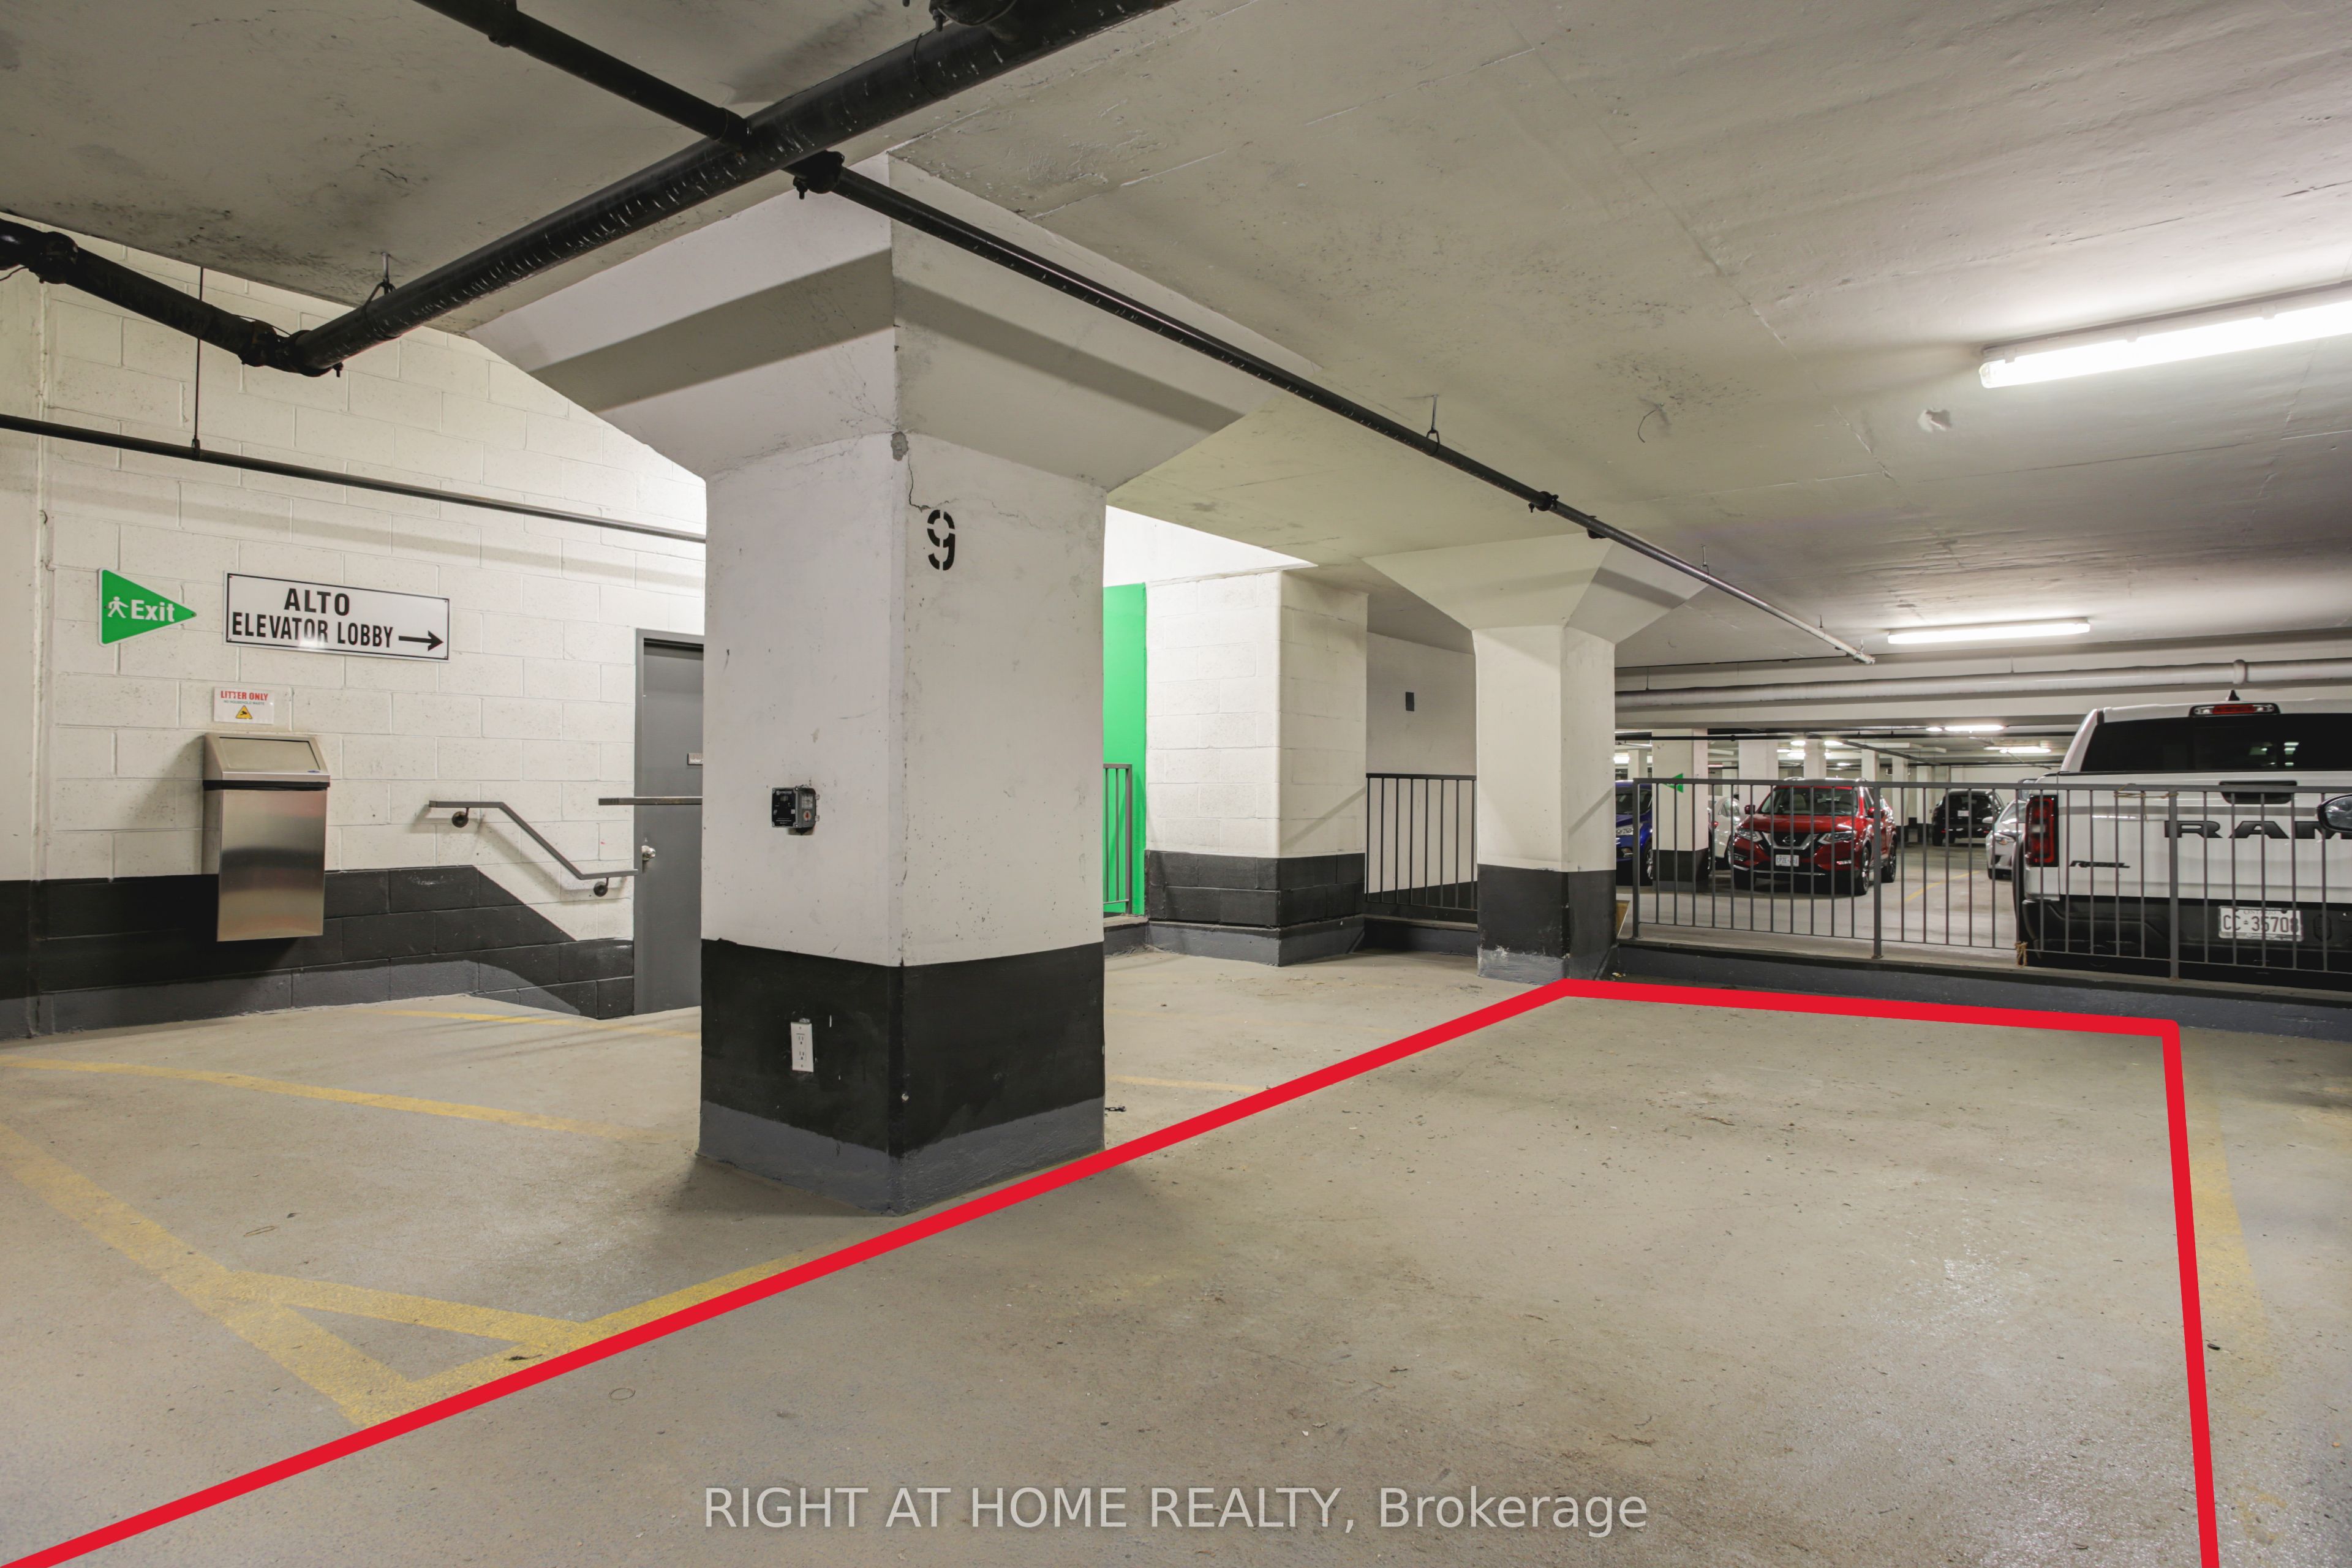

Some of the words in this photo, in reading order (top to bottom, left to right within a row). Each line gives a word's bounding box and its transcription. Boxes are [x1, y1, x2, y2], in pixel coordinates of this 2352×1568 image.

[927, 509, 956, 571] 9
[131, 599, 175, 622] Exit
[284, 587, 350, 616] ALTO
[232, 611, 329, 643] ELEVATOR
[337, 621, 393, 648] LOBBY
[221, 690, 247, 699] LITTER
[249, 692, 268, 701] ONLY
